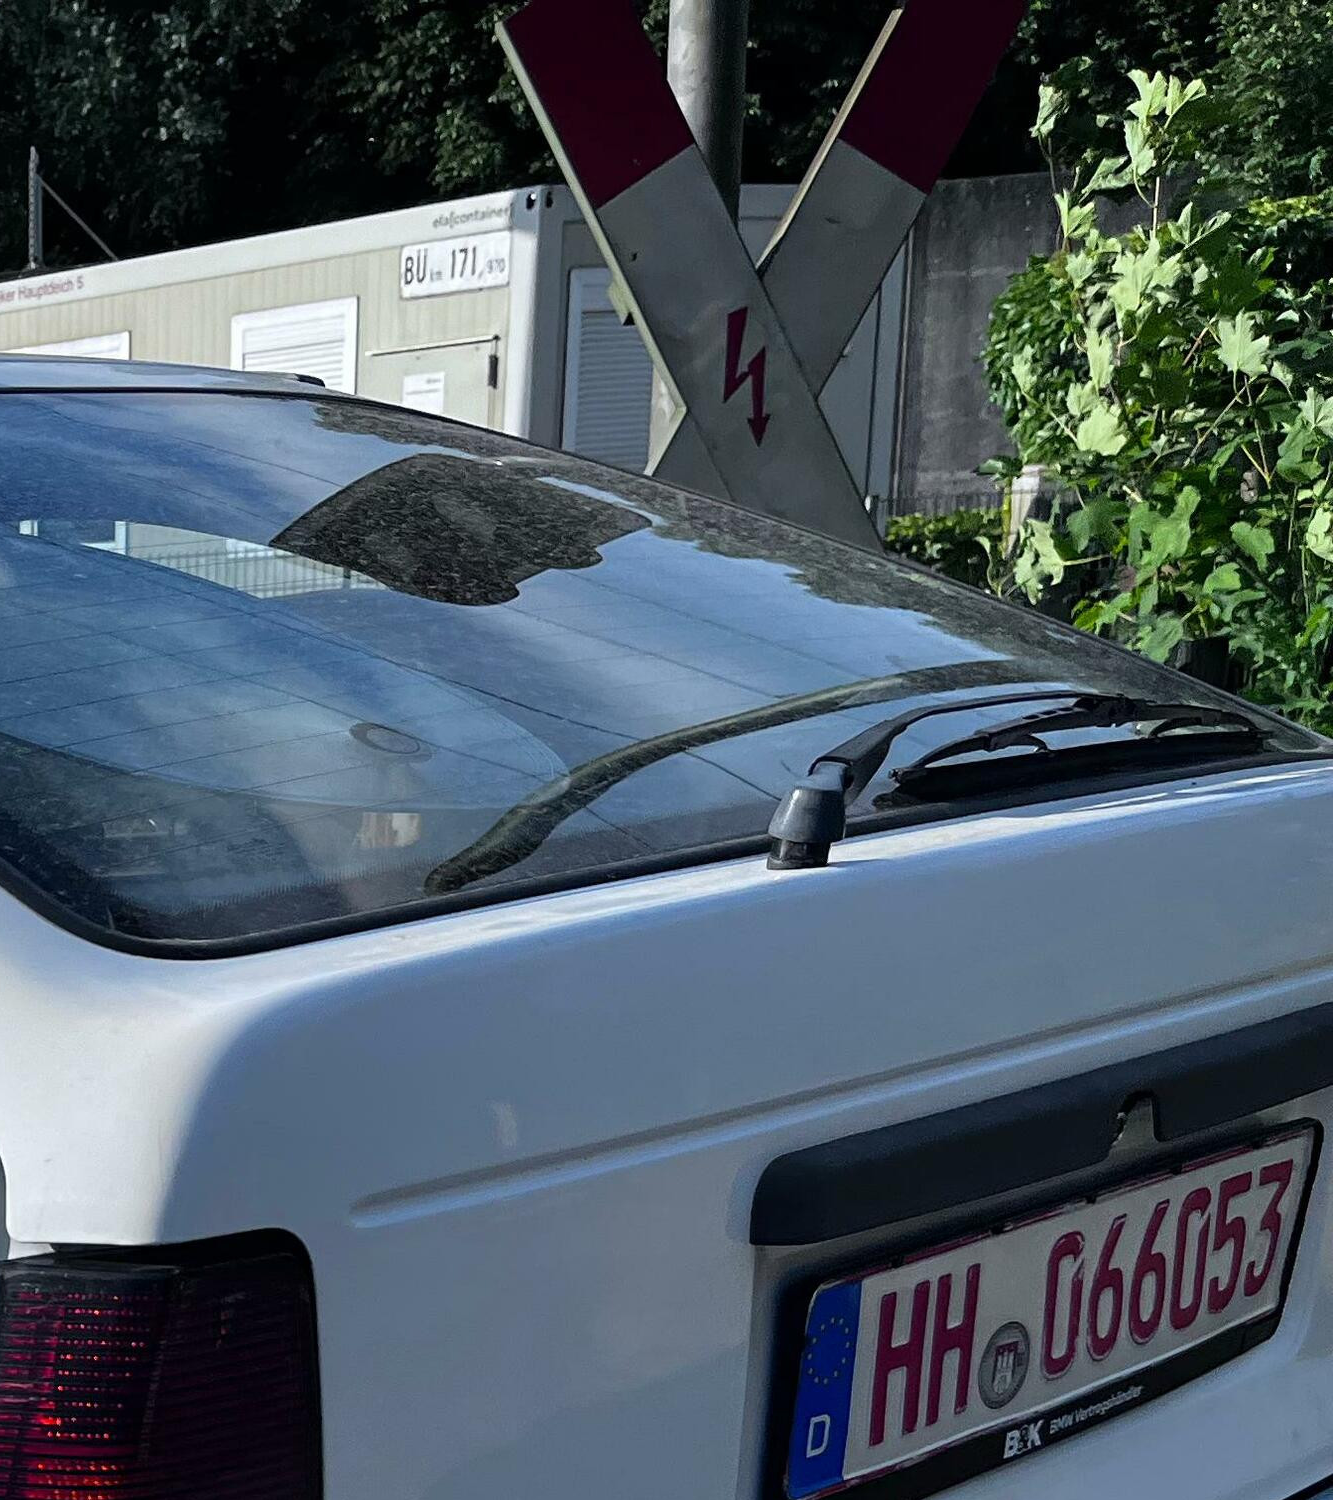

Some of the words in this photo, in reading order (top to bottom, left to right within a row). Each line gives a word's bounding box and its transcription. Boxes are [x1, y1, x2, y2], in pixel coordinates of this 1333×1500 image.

[869, 1263, 981, 1447] HH
[1042, 1158, 1294, 1381] 066053
[805, 1413, 831, 1459] D
